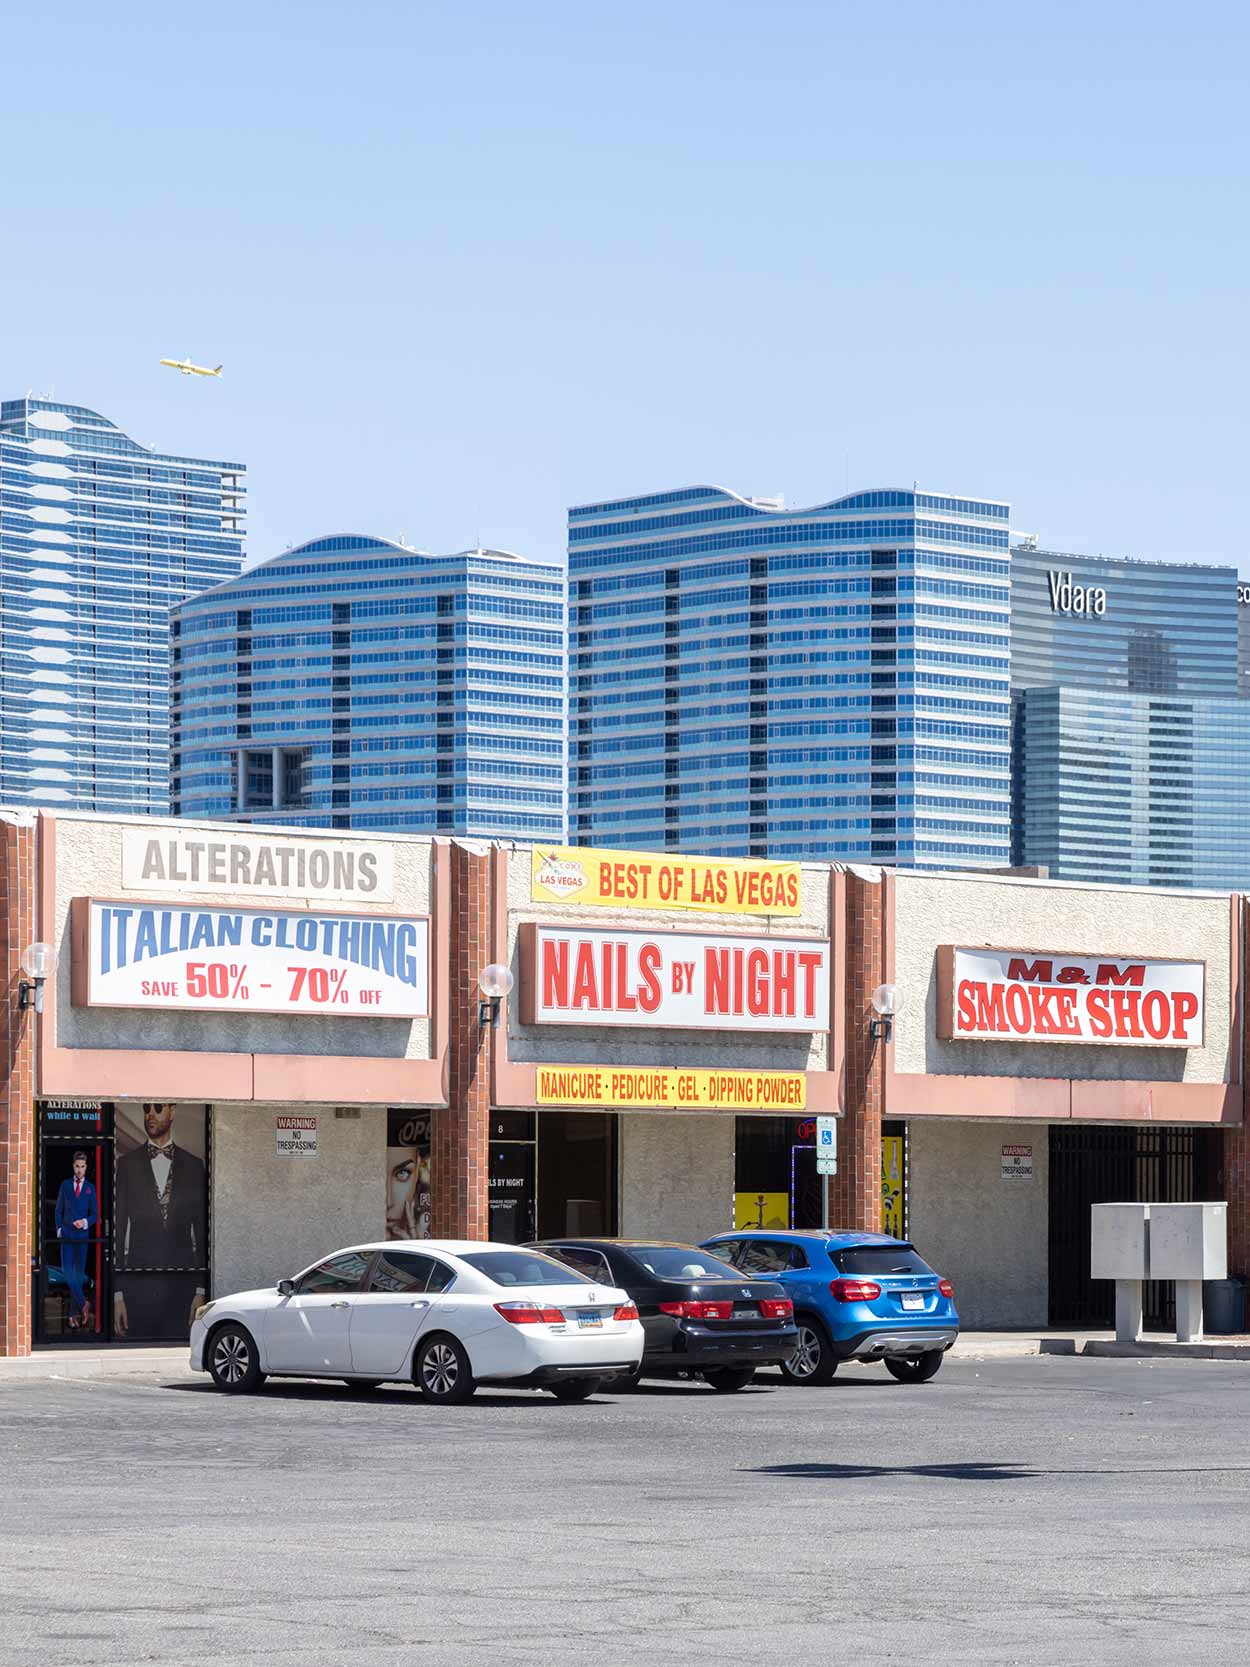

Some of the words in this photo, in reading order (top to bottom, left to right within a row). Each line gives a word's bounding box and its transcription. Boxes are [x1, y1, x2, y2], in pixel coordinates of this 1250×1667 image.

[1049, 570, 1106, 615] Vdara
[141, 839, 378, 892] ALTERATIONS
[540, 875, 556, 885] LAS
[558, 876, 583, 887] VEGAS
[600, 862, 651, 899] BEST
[658, 866, 685, 901] OF
[690, 868, 728, 904] LAS
[734, 871, 798, 908] VEGAS
[101, 908, 243, 976] ITALIAN
[251, 917, 417, 988] CLOTHING
[142, 980, 180, 998] SAVE
[186, 962, 249, 1000] 50%
[287, 967, 349, 1004] 70%
[359, 989, 382, 1005] OFF
[542, 938, 663, 1014] NAILS
[671, 961, 696, 995] BY
[704, 946, 823, 1018] NIGHT
[957, 979, 1083, 1036] SMOKE
[1086, 988, 1199, 1040] SHOP
[541, 1072, 602, 1100] MANICURE
[612, 1074, 668, 1102] PEDICURE
[677, 1076, 699, 1102] GEL
[709, 1076, 753, 1103] DIPPING
[756, 1077, 802, 1104] POWDER
[47, 1100, 102, 1110] ALTERATIONS
[47, 1111, 72, 1120] while
[278, 1118, 316, 1129] WARNING
[292, 1130, 302, 1140] NO
[277, 1140, 317, 1150] TRESPASSING
[1002, 1146, 1032, 1156] WARNING
